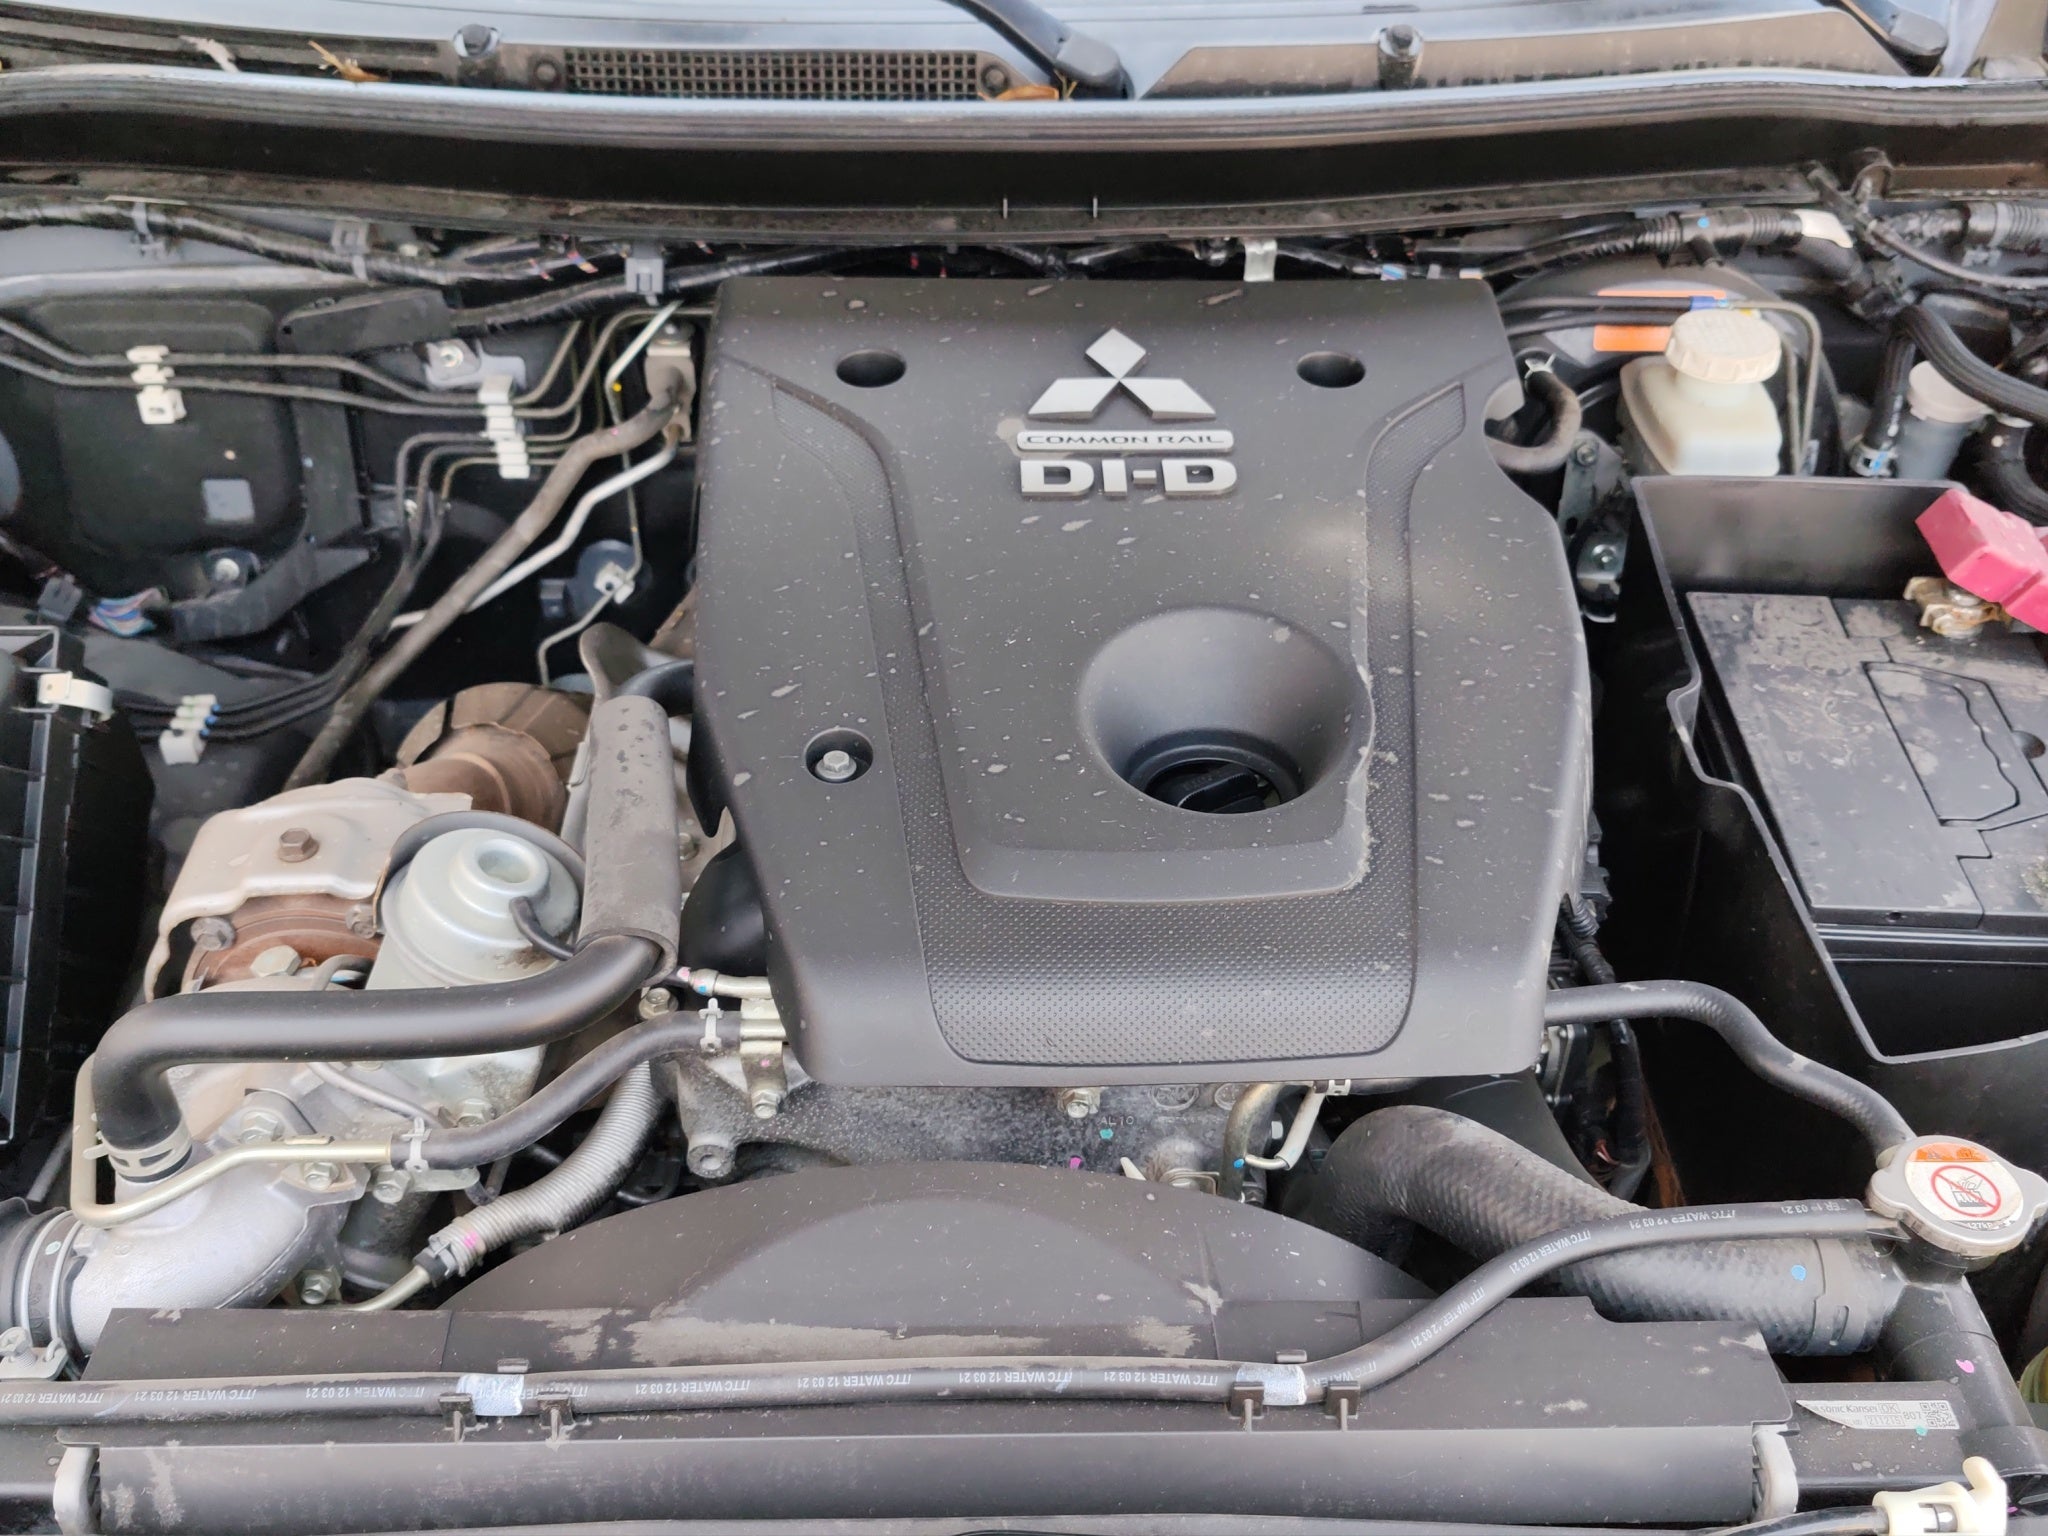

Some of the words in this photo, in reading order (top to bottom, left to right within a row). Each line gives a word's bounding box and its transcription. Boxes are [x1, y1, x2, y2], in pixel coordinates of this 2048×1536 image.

[1026, 434, 1148, 444] COMMON
[1157, 434, 1225, 443] RAIL
[1020, 458, 1237, 498] DI-D
[1781, 1205, 1794, 1214] 21
[1794, 1204, 1809, 1214] 03
[1643, 1217, 1654, 1227] 03
[1538, 1237, 1571, 1257] WATER
[1528, 1250, 1539, 1262] 12
[1519, 1256, 1529, 1268] 03
[1509, 1262, 1520, 1274] 21
[1421, 1328, 1432, 1341] 03
[1410, 1335, 1422, 1349] 21
[827, 1376, 839, 1387] 12
[843, 1374, 884, 1387] WATER
[959, 1372, 971, 1383] 21
[973, 1372, 986, 1383] 03
[989, 1372, 1001, 1383] 12
[1004, 1372, 1045, 1383] WATER
[1104, 1371, 1116, 1382] 21
[1119, 1372, 1131, 1382] 03
[1134, 1372, 1146, 1382] 12
[1150, 1372, 1190, 1385] WATER
[681, 1382, 722, 1393] WATER
[797, 1378, 809, 1388] 21
[812, 1377, 824, 1388] 03
[305, 1387, 318, 1398] 21
[321, 1387, 335, 1398] 03
[338, 1386, 351, 1398] 12
[354, 1386, 396, 1398] WATER
[635, 1384, 647, 1394] 21
[650, 1383, 663, 1394] 03
[666, 1383, 677, 1394] 12
[1, 1393, 11, 1403] 21
[12, 1393, 24, 1403] 03
[25, 1392, 36, 1403] 12
[38, 1392, 77, 1403] WATER
[134, 1391, 147, 1402] 21
[150, 1391, 163, 1401] 03
[166, 1390, 178, 1401] 12
[183, 1390, 226, 1401] WATER
[1881, 1403, 1899, 1413] OK
